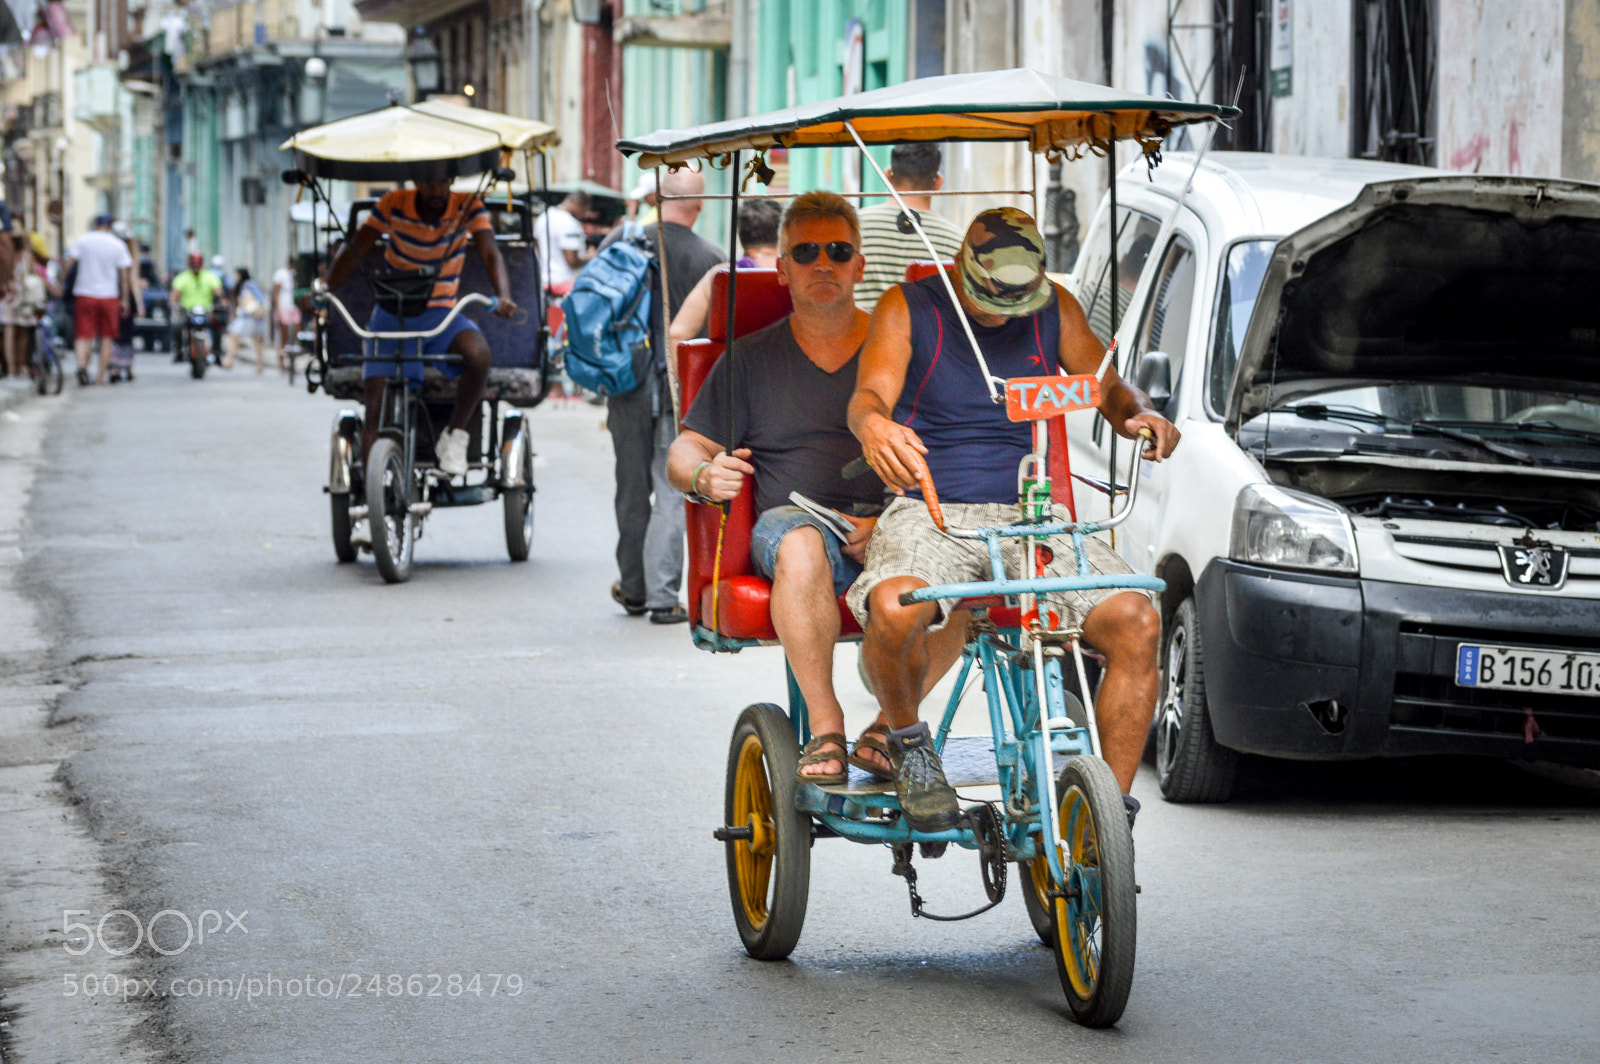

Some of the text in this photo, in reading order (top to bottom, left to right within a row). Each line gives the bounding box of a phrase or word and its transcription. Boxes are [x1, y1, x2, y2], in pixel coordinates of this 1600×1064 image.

[1010, 380, 1091, 410] TAXI
[1465, 651, 1473, 680] CUBA
[1480, 654, 1496, 683] B
[1502, 656, 1552, 686] 156
